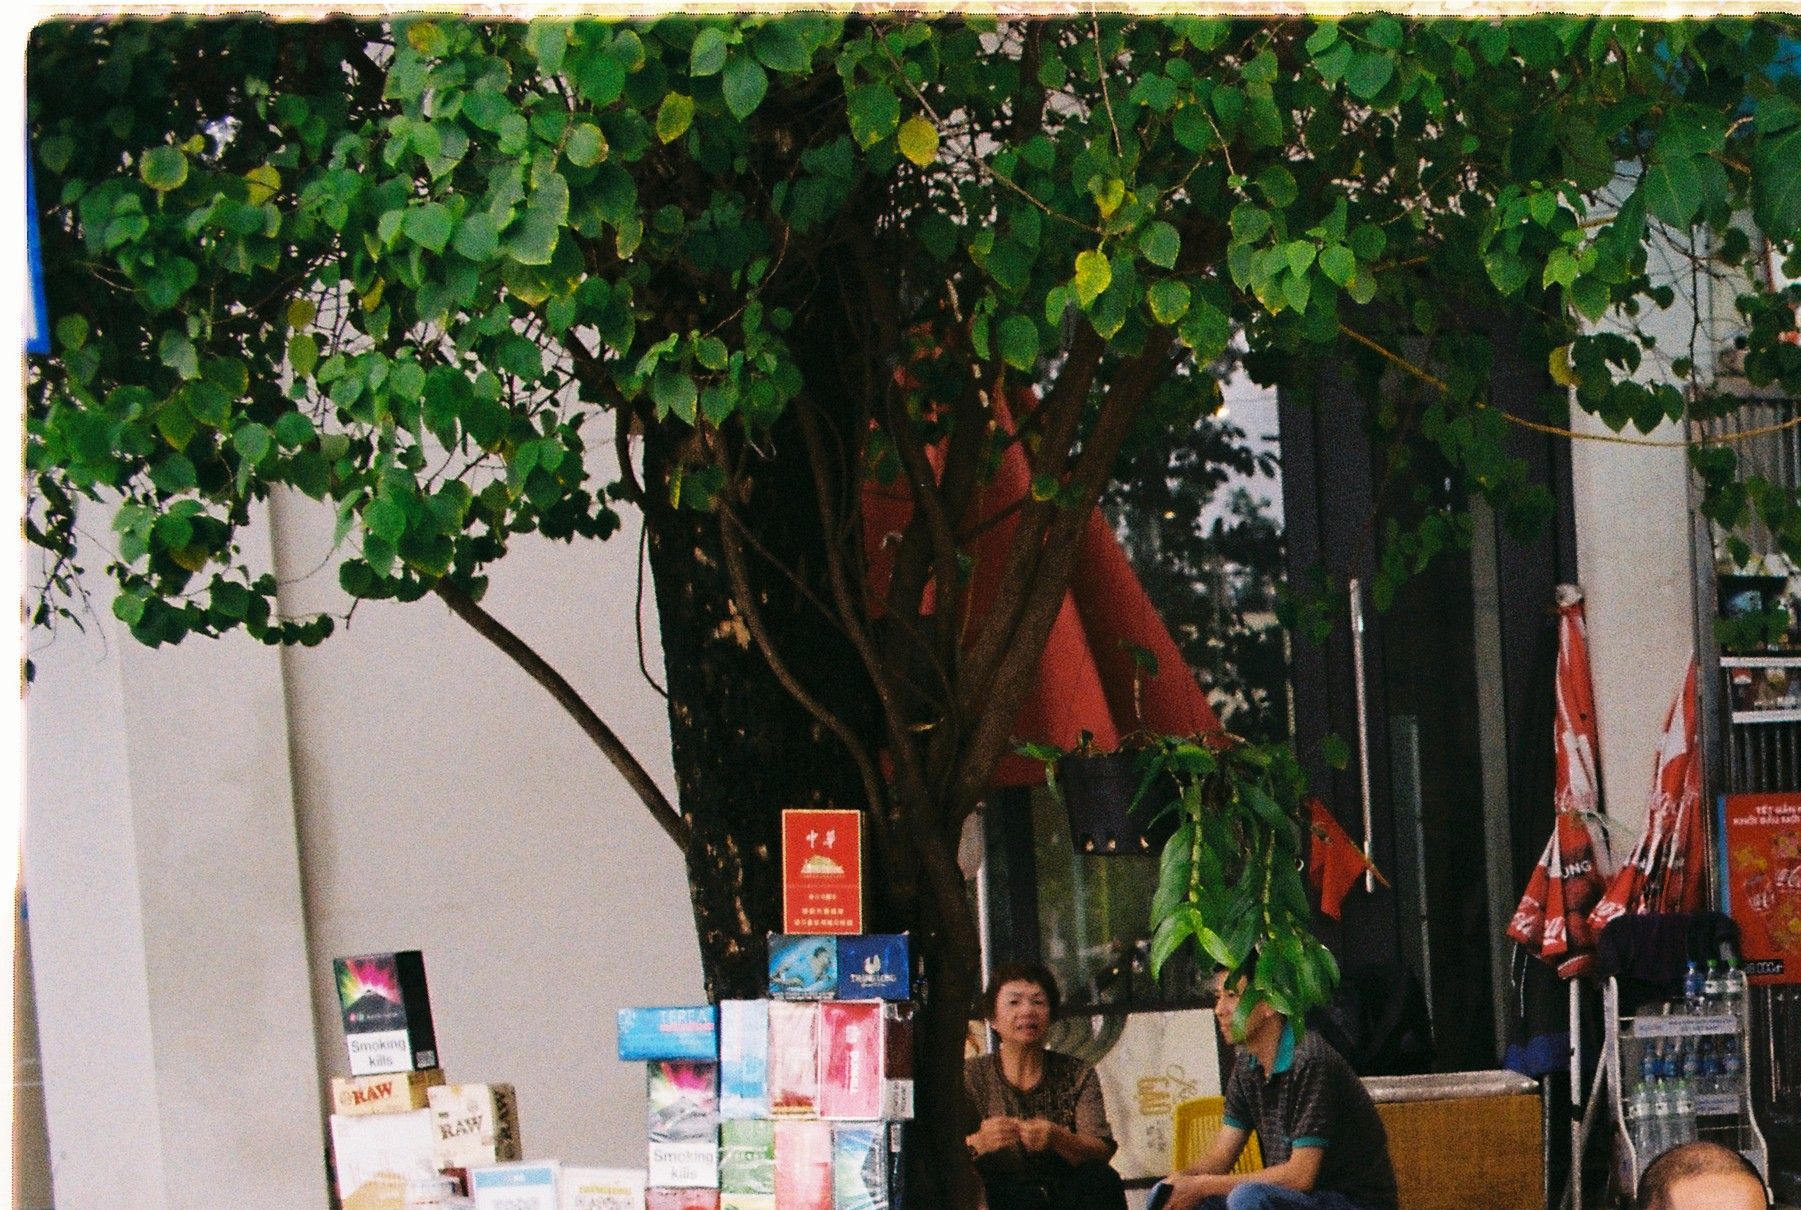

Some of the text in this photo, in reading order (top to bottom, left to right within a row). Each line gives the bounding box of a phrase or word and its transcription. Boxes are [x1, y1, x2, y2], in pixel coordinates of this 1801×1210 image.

[351, 1038, 406, 1055] Smoking
[369, 1054, 393, 1067] kills
[352, 1081, 394, 1106] RAW
[437, 1114, 484, 1141] RAW
[653, 1148, 714, 1166] Smoking
[671, 1165, 697, 1179] kills
